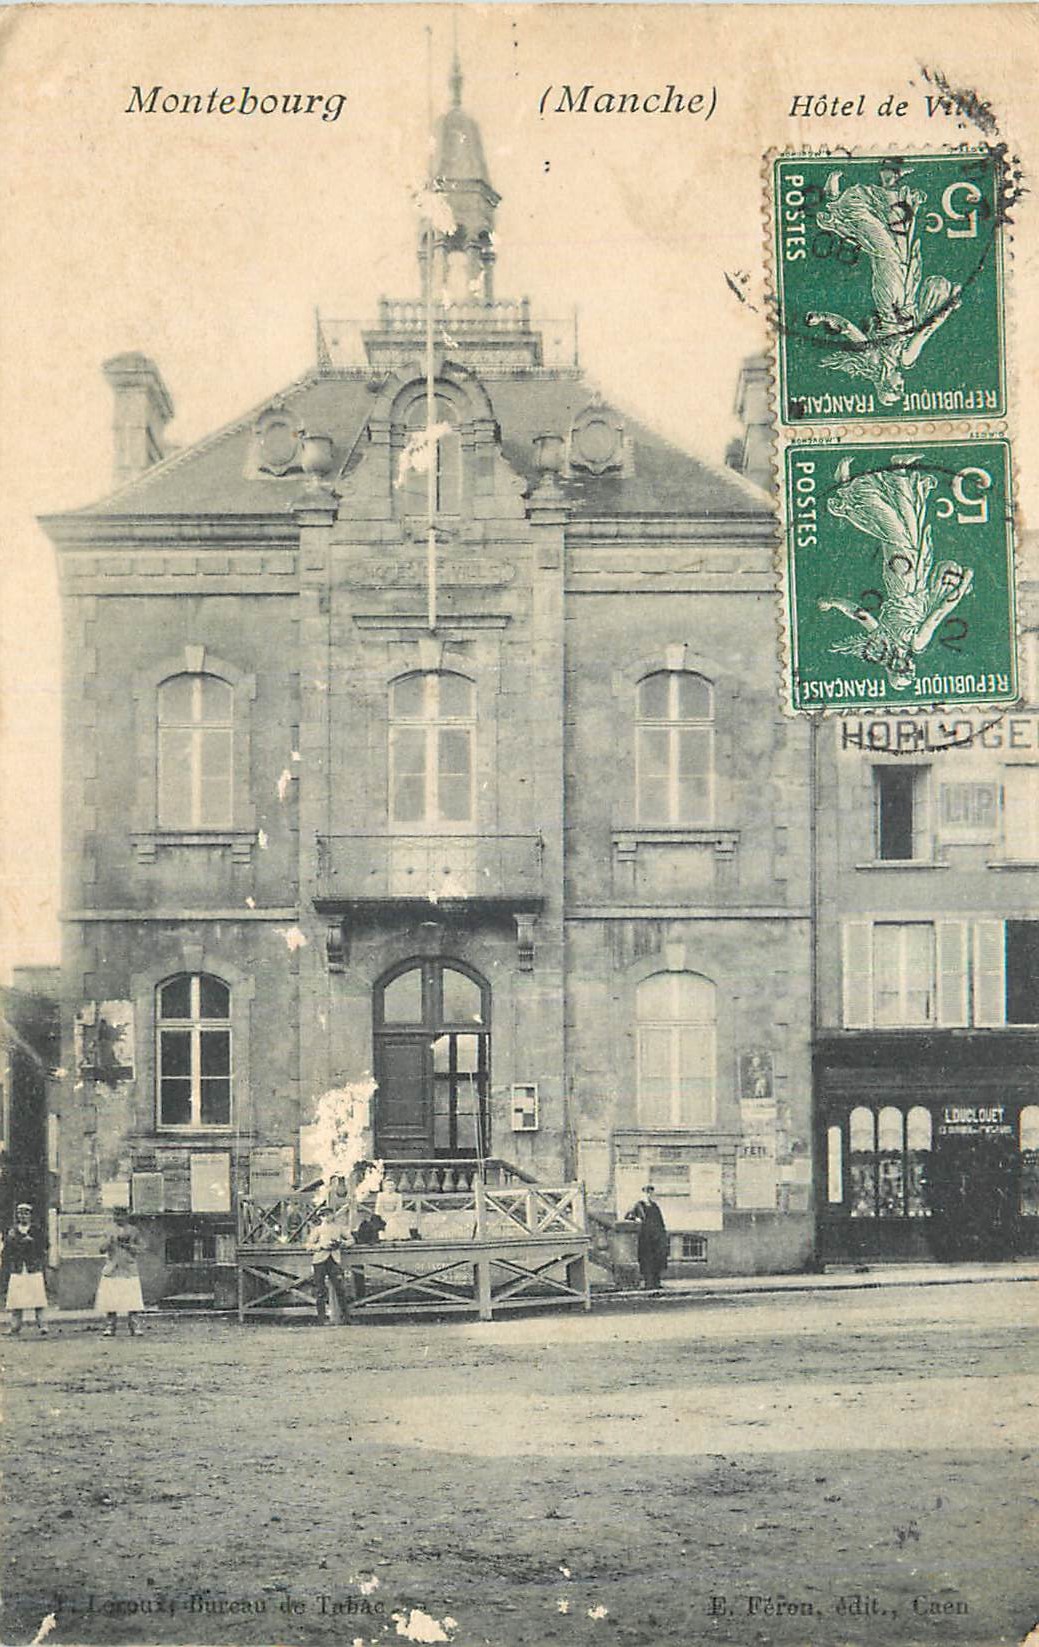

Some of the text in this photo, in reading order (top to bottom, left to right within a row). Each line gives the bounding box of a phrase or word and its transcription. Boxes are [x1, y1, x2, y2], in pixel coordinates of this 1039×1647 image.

[784, 174, 807, 262] POSTES
[795, 461, 818, 548] POSTES
[802, 678, 887, 700] FRANÇAISE
[841, 719, 1039, 752] HORLOGE
